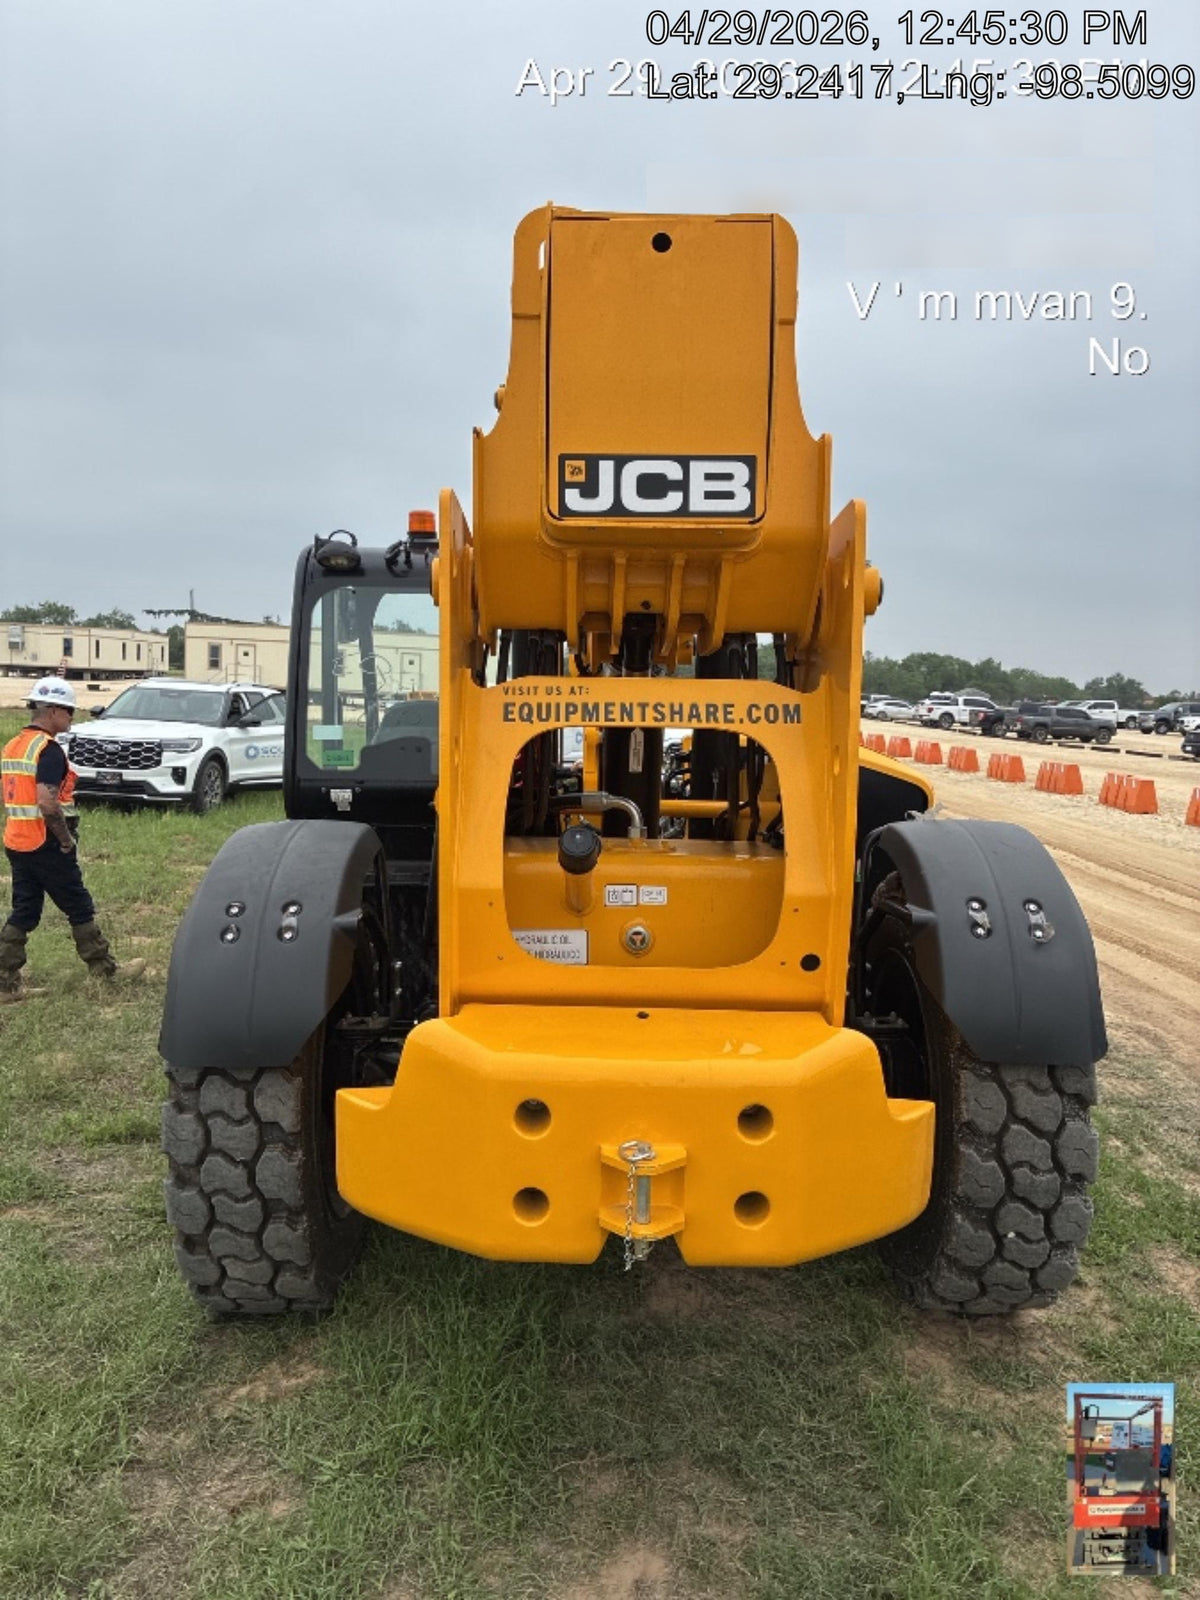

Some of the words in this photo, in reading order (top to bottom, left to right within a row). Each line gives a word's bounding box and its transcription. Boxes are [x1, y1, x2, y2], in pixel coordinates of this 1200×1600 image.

[564, 459, 751, 513] JCB
[502, 686, 540, 696] VISIT
[545, 686, 562, 696] US
[569, 686, 590, 696] AT:
[502, 701, 802, 725] EQUIPMENTSHARE.COM
